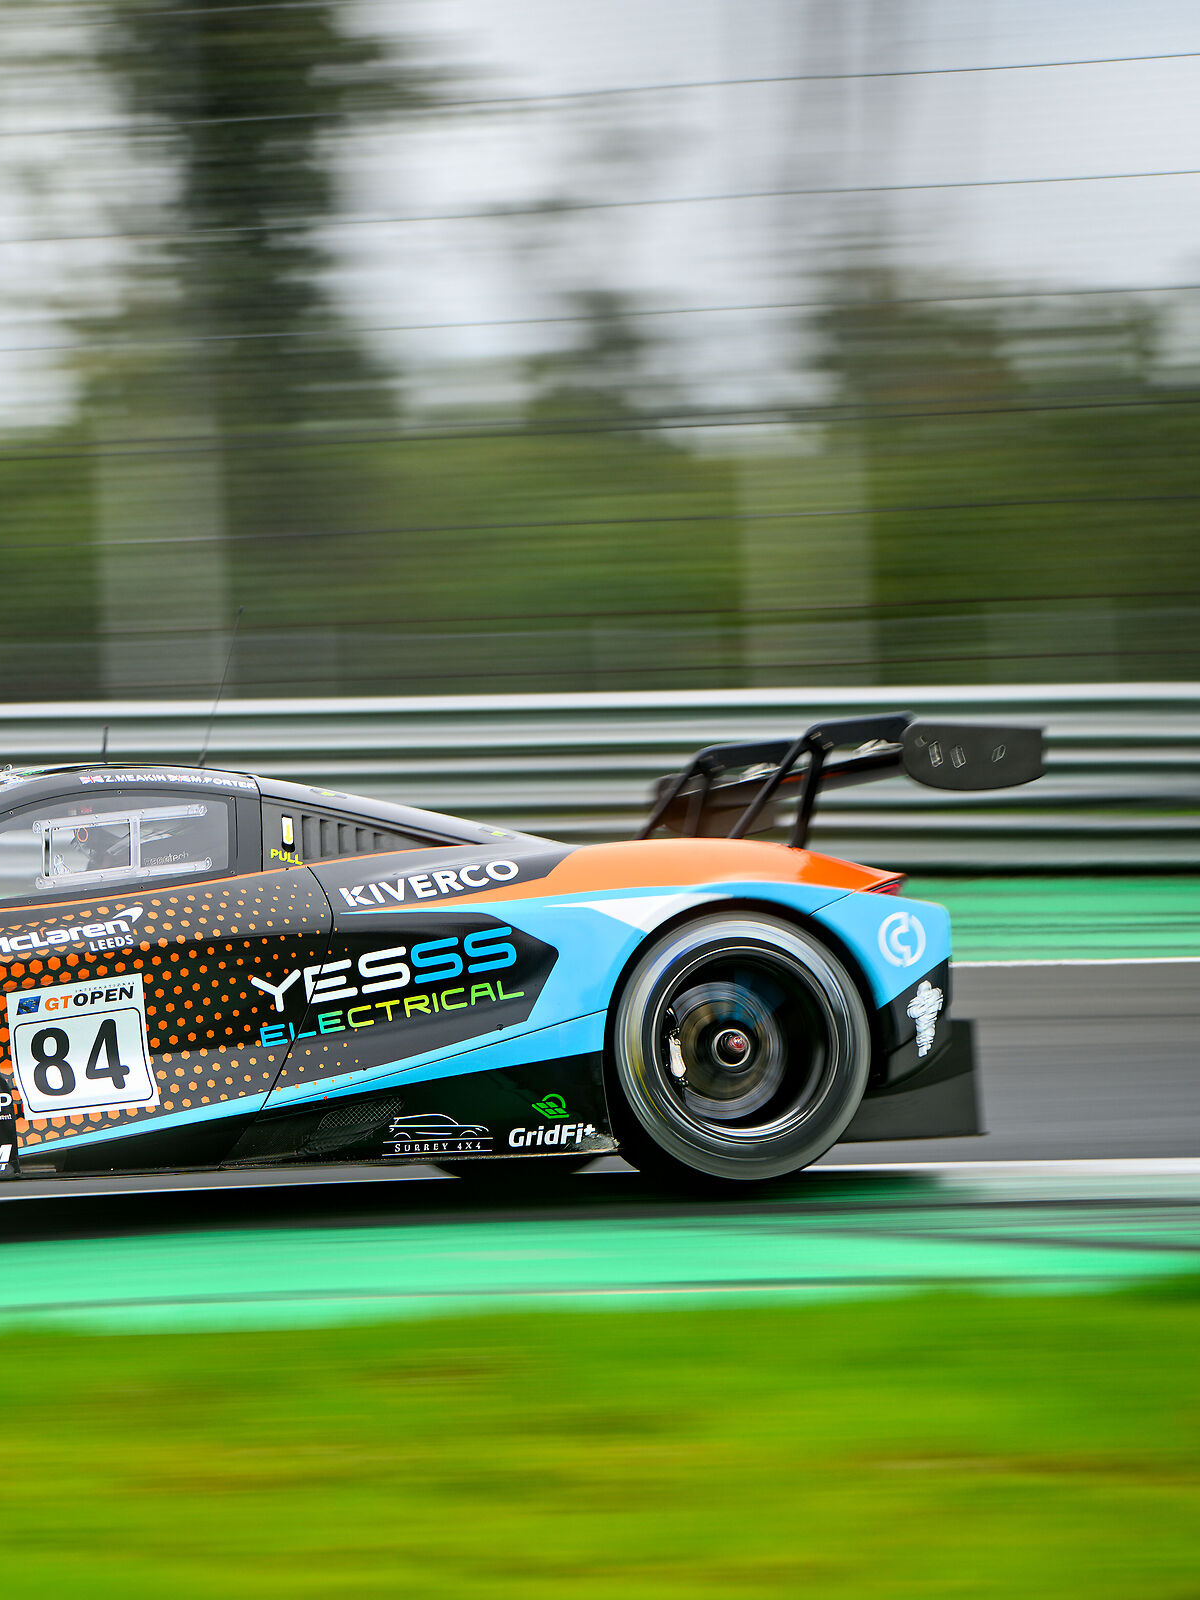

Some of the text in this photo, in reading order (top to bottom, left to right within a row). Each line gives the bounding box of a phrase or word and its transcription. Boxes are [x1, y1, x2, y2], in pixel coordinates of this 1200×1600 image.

[270, 848, 303, 866] PULL
[338, 860, 519, 907] KIVERCO
[88, 934, 134, 952] LEEDS
[250, 926, 518, 1013] YESSS
[259, 980, 525, 1048] ELECTRICAL
[30, 1018, 131, 1097] 84
[394, 1141, 449, 1153] SURREY
